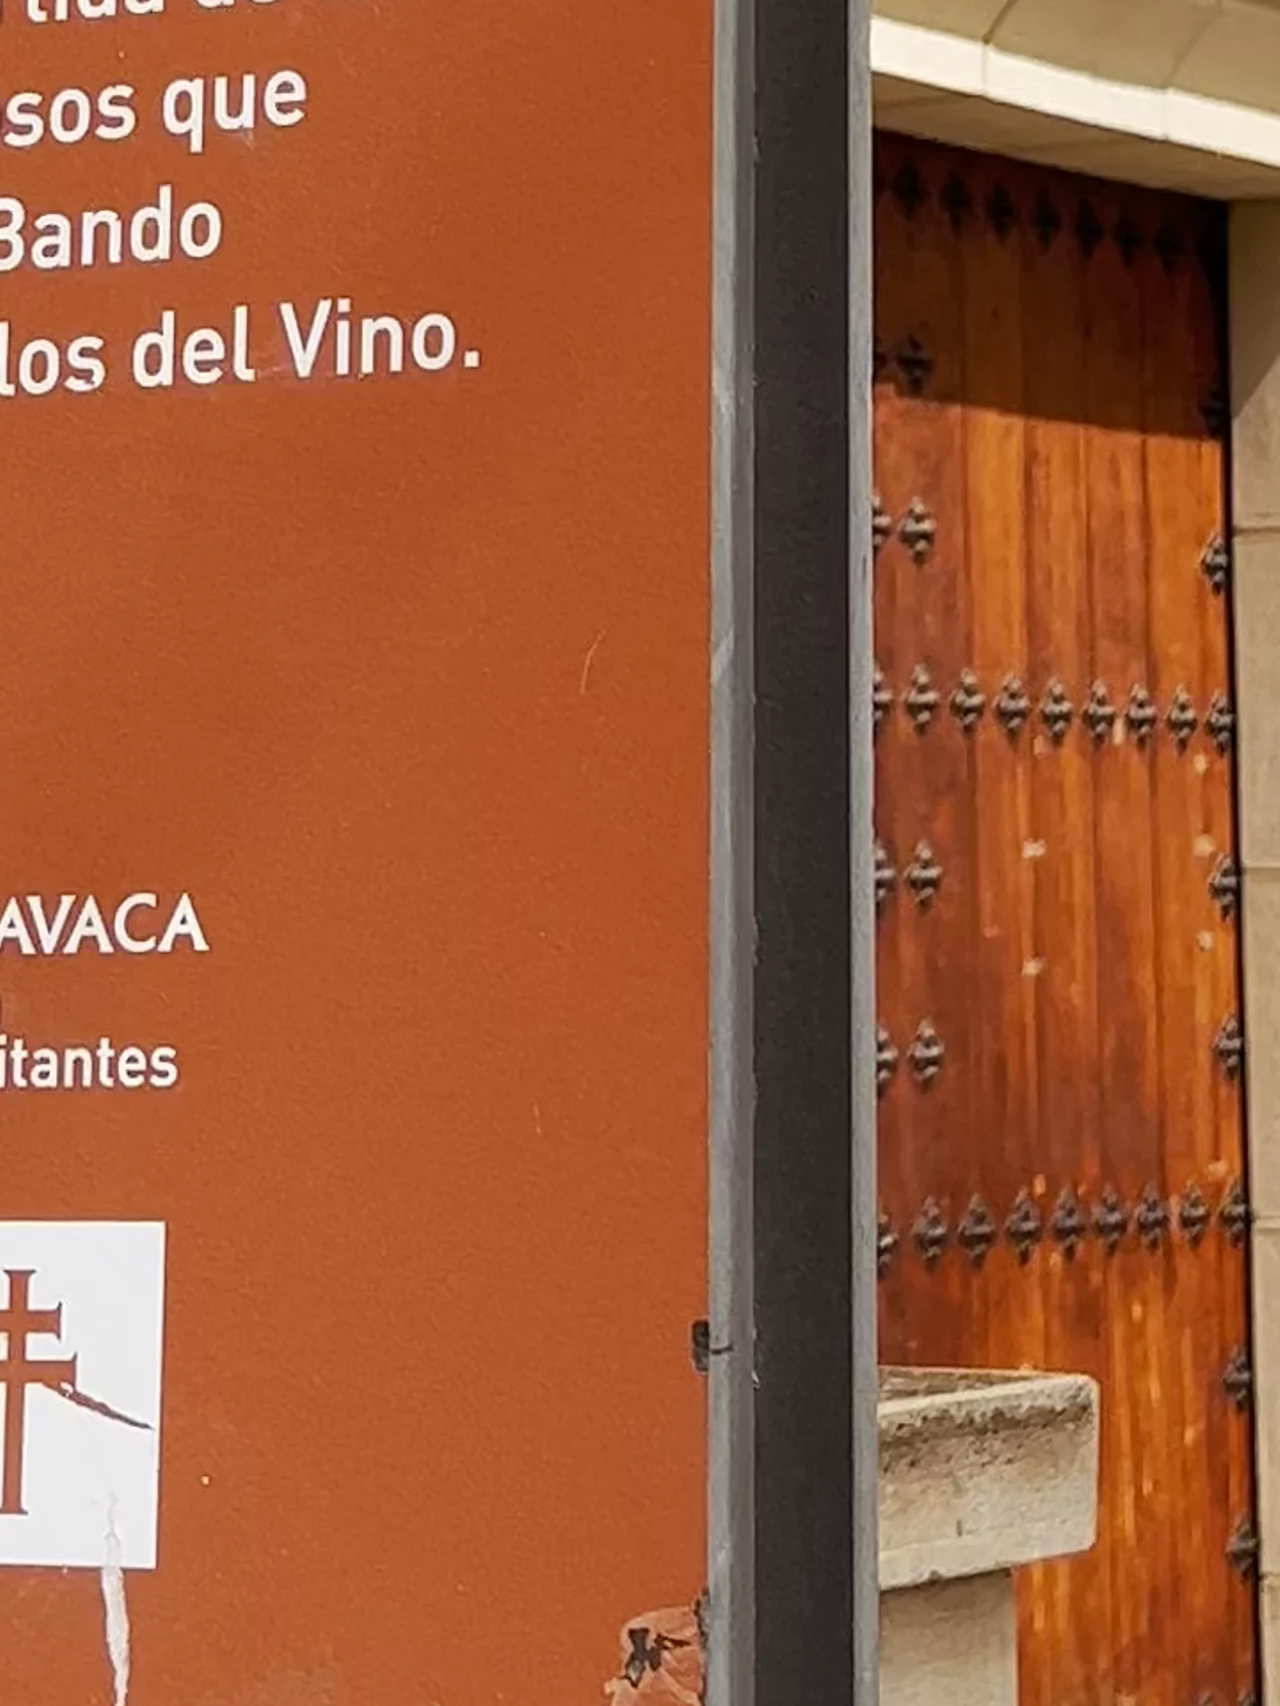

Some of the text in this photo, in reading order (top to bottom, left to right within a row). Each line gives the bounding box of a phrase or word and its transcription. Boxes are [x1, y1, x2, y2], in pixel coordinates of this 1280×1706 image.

[161, 69, 307, 154] que
[131, 304, 256, 389] del
[278, 297, 480, 379] Vino.
